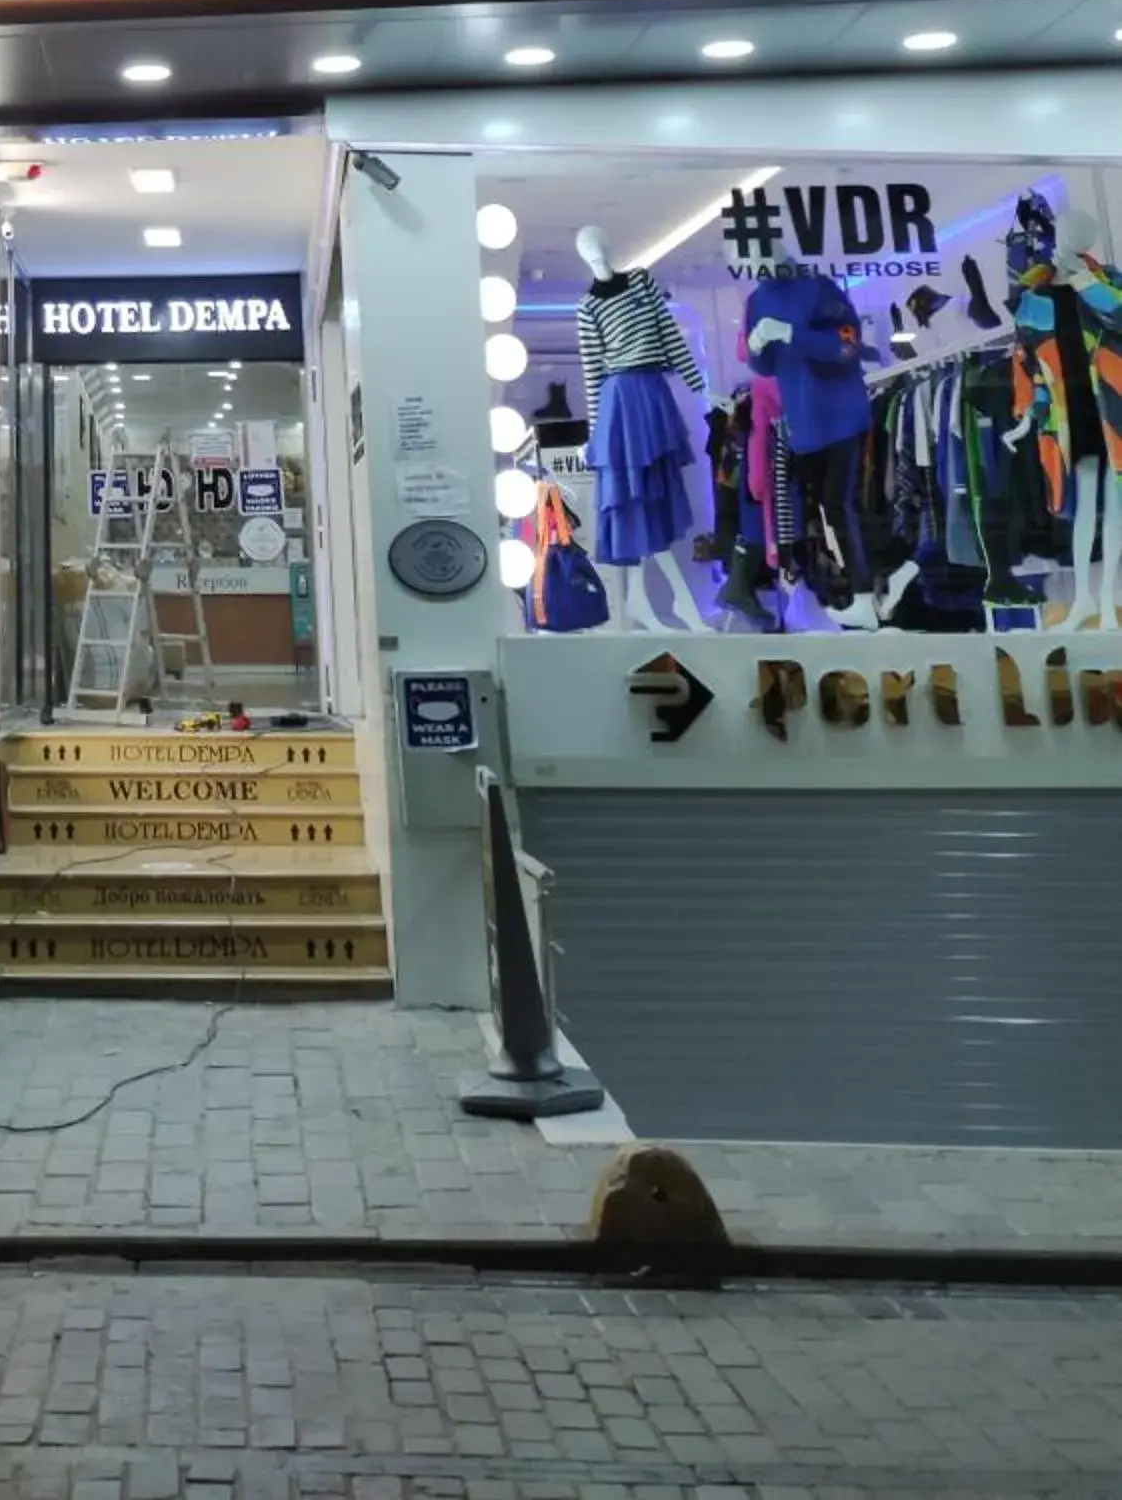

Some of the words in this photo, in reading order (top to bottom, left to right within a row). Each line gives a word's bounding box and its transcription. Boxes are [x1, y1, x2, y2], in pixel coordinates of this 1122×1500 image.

[721, 183, 938, 259] #VDR
[727, 260, 942, 281] VIADELLEROSE
[42, 301, 162, 335] HOTEL
[168, 298, 291, 333] DEMPA
[197, 467, 235, 511] HD
[410, 682, 465, 692] PLEASE
[412, 723, 455, 733] WEAR
[458, 723, 470, 733] A
[420, 735, 461, 745] MASK
[108, 779, 259, 801] WELCOME
